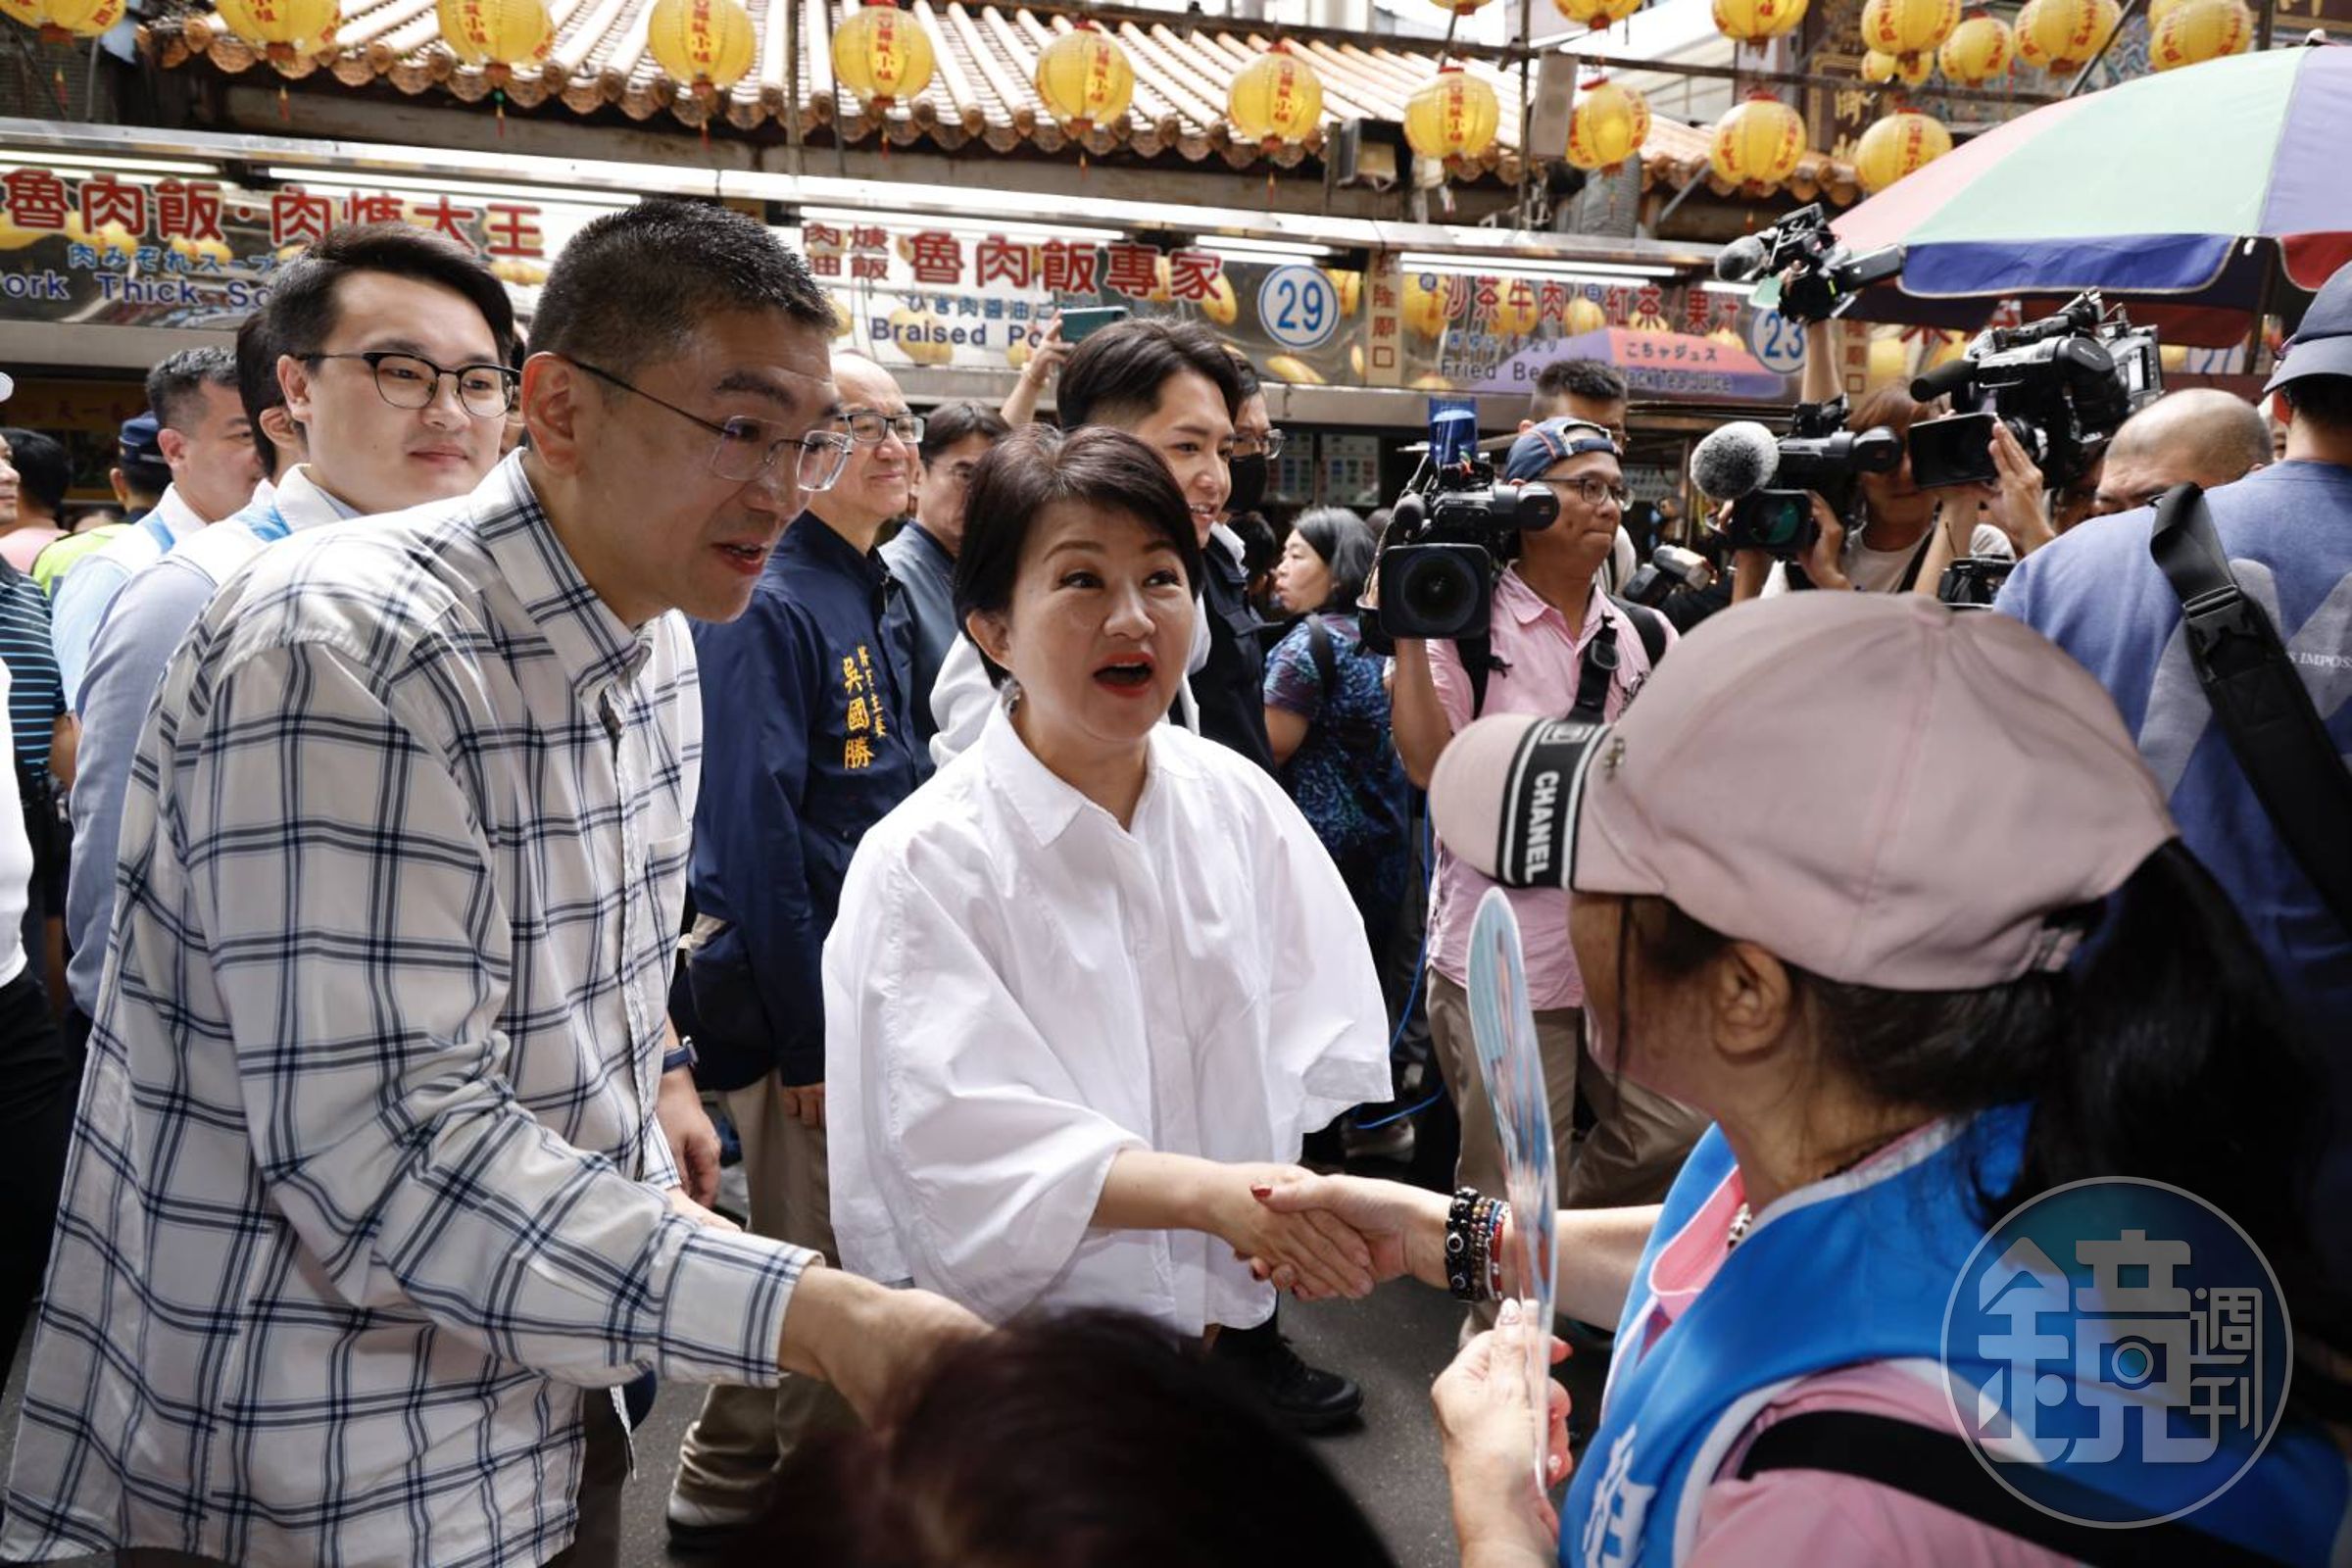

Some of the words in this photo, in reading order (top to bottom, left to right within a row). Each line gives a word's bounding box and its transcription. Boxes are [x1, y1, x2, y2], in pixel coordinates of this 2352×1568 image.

[4, 270, 70, 299] ork
[95, 274, 199, 306] Thick
[910, 228, 1223, 301] 魯肉飯專家
[1276, 279, 1322, 331] 29
[1443, 274, 1565, 323] 沙茶牛肉
[872, 318, 987, 345] Braised
[1765, 312, 1804, 359] 23
[1442, 359, 1496, 380] Fried
[843, 656, 875, 769] 吳國勝
[1525, 770, 1561, 884] CHANEL
